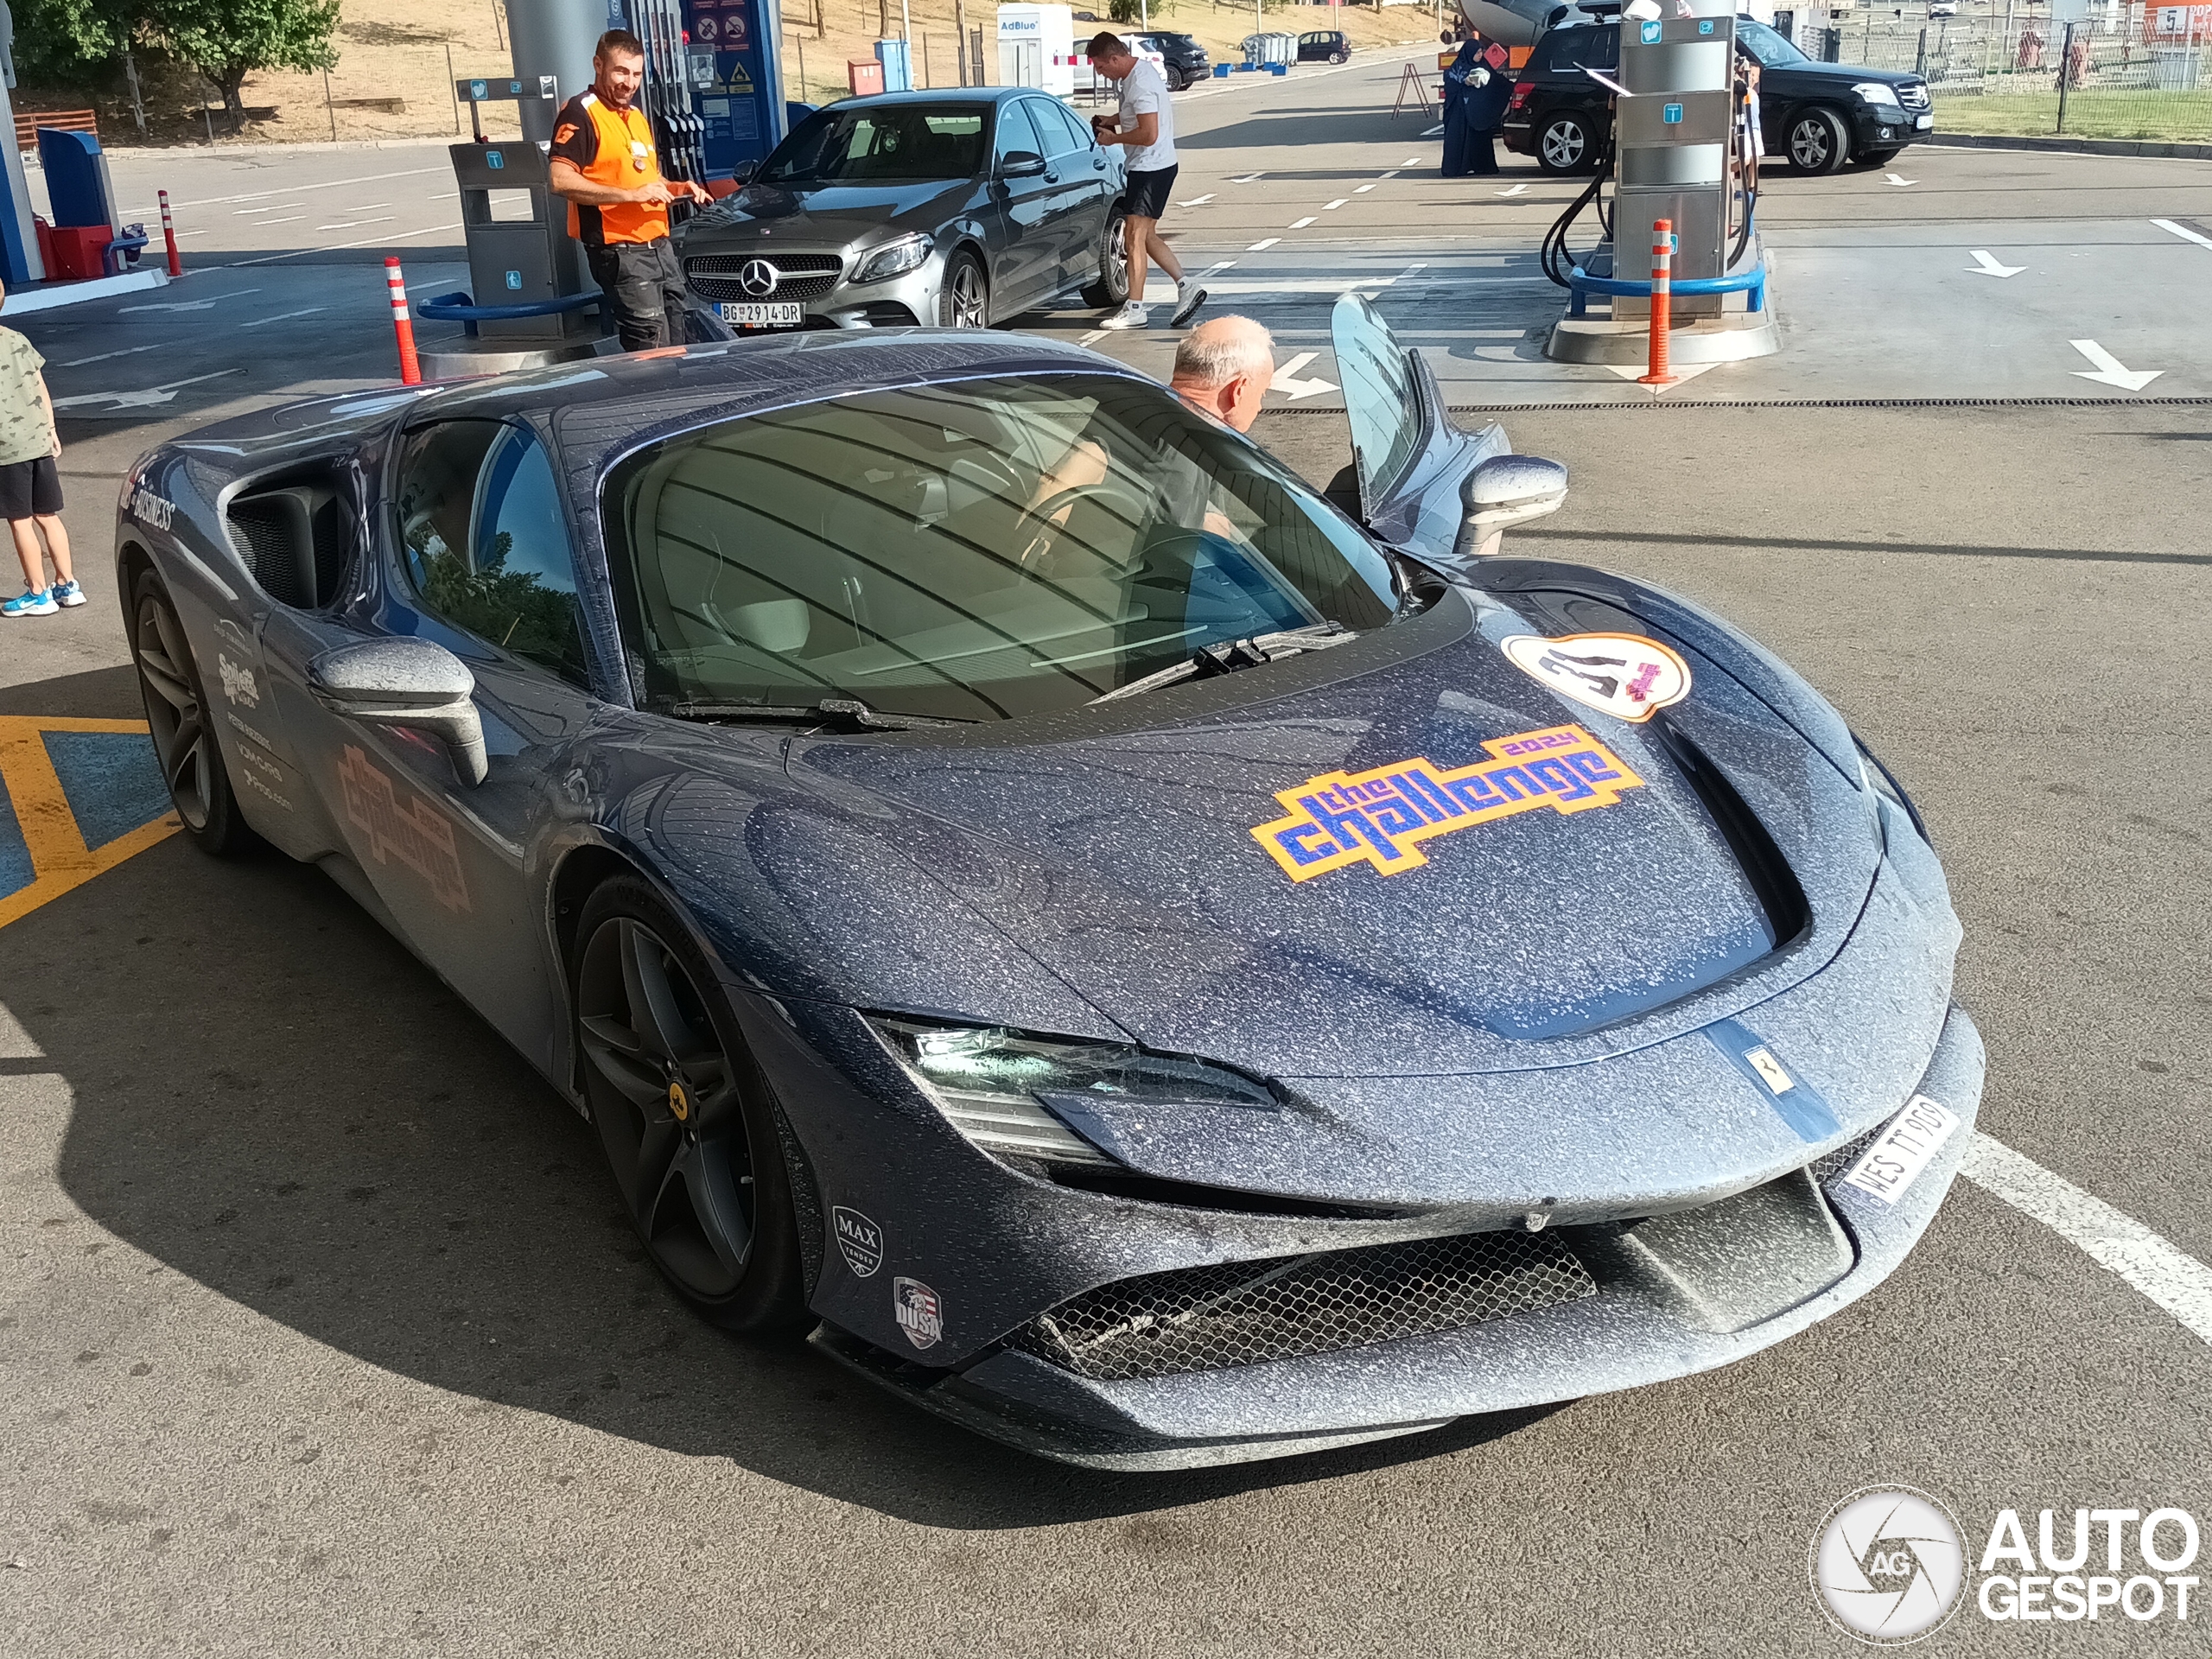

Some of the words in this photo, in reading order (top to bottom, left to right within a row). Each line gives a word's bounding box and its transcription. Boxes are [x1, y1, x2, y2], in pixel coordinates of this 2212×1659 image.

[1001, 21, 1036, 30] AdBlue
[722, 305, 737, 321] BG
[133, 488, 176, 532] BUSINESS
[1498, 731, 1582, 758] 2024
[1271, 750, 1623, 866] challenge
[1320, 777, 1394, 811] the
[1854, 1154, 1905, 1194] WES
[1885, 1128, 1925, 1156] TT
[837, 1215, 879, 1249] MAX
